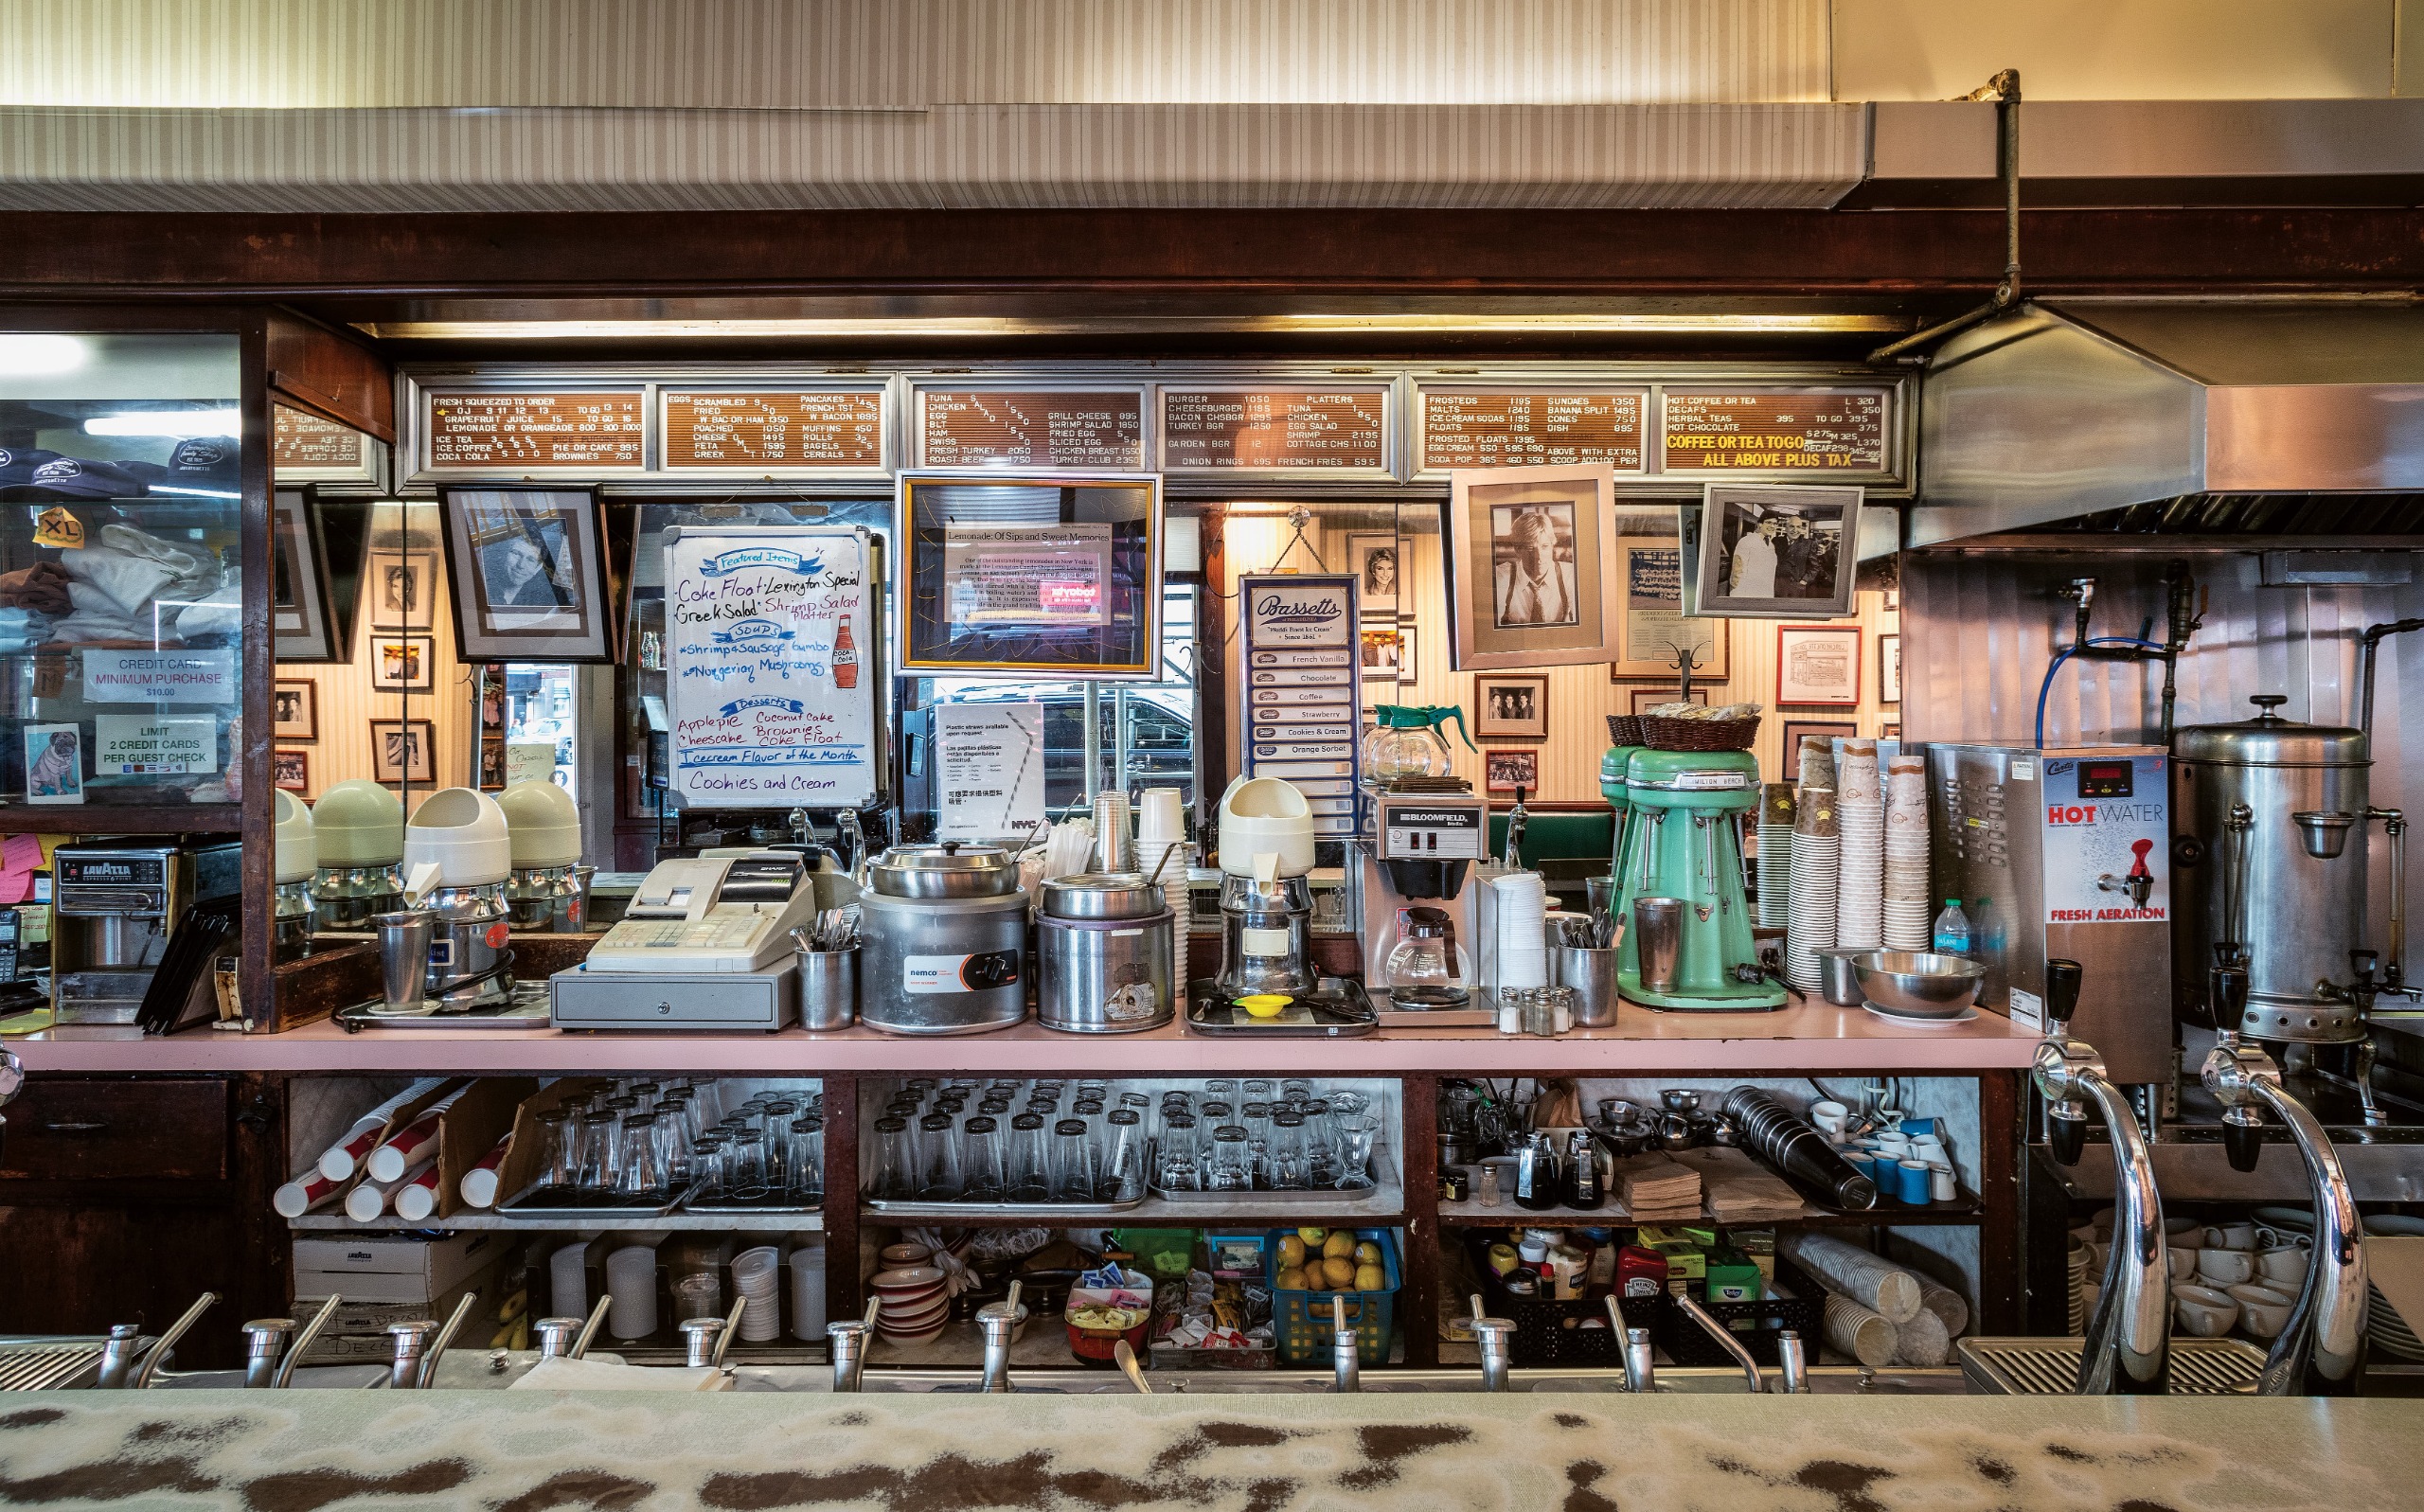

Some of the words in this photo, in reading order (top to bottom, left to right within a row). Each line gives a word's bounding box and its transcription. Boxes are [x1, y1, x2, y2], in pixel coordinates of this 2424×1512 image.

[1667, 436, 1716, 449] COFFEE
[1719, 436, 1736, 449] OR
[1738, 436, 1764, 449] TEA
[1703, 454, 1728, 467] ALL
[1735, 454, 1779, 467] ABOVE
[1786, 454, 1820, 467] PLUS
[1827, 454, 1852, 467] TAX
[45, 519, 78, 536] XL
[1007, 532, 1023, 542] Sips
[721, 552, 762, 568] Featured
[766, 552, 797, 565] Items
[678, 580, 717, 602] Coke
[722, 577, 762, 598] Float
[765, 577, 820, 596] Lexington
[823, 571, 860, 591] Special
[676, 604, 722, 624] Greek
[723, 599, 758, 618] Salad
[765, 597, 817, 613] Shrimp
[819, 596, 859, 609] Salad
[1257, 596, 1342, 615] Bassetts
[793, 611, 835, 621] Platter
[119, 660, 165, 669] CREDIT
[169, 660, 201, 669] CARD
[96, 674, 152, 684] MINIMUM
[156, 674, 222, 684] PURCHASE
[740, 698, 786, 708] Desserts
[757, 712, 802, 723] Coconut
[807, 713, 834, 721] Cake
[753, 724, 822, 737] Brownies
[804, 732, 843, 743] Float
[110, 740, 116, 749] 2
[119, 740, 158, 749] CREDIT
[162, 740, 200, 749] CARDS
[104, 754, 125, 762] PER
[129, 754, 165, 762] GUEST
[168, 754, 206, 762] CHECK
[742, 751, 781, 762] Flavor
[786, 749, 796, 760] of
[798, 749, 816, 759] the
[821, 749, 857, 759] Month
[2047, 761, 2074, 775] Curtis
[689, 771, 758, 790] Cookies
[764, 774, 785, 789] and
[792, 776, 835, 790] Cream
[2048, 806, 2096, 824] HOT
[2098, 805, 2163, 822] WATER
[1011, 821, 1036, 829] NYC
[83, 863, 131, 875] LAVAZZA
[2051, 909, 2092, 921] FRESH
[2096, 908, 2165, 919] AERATION
